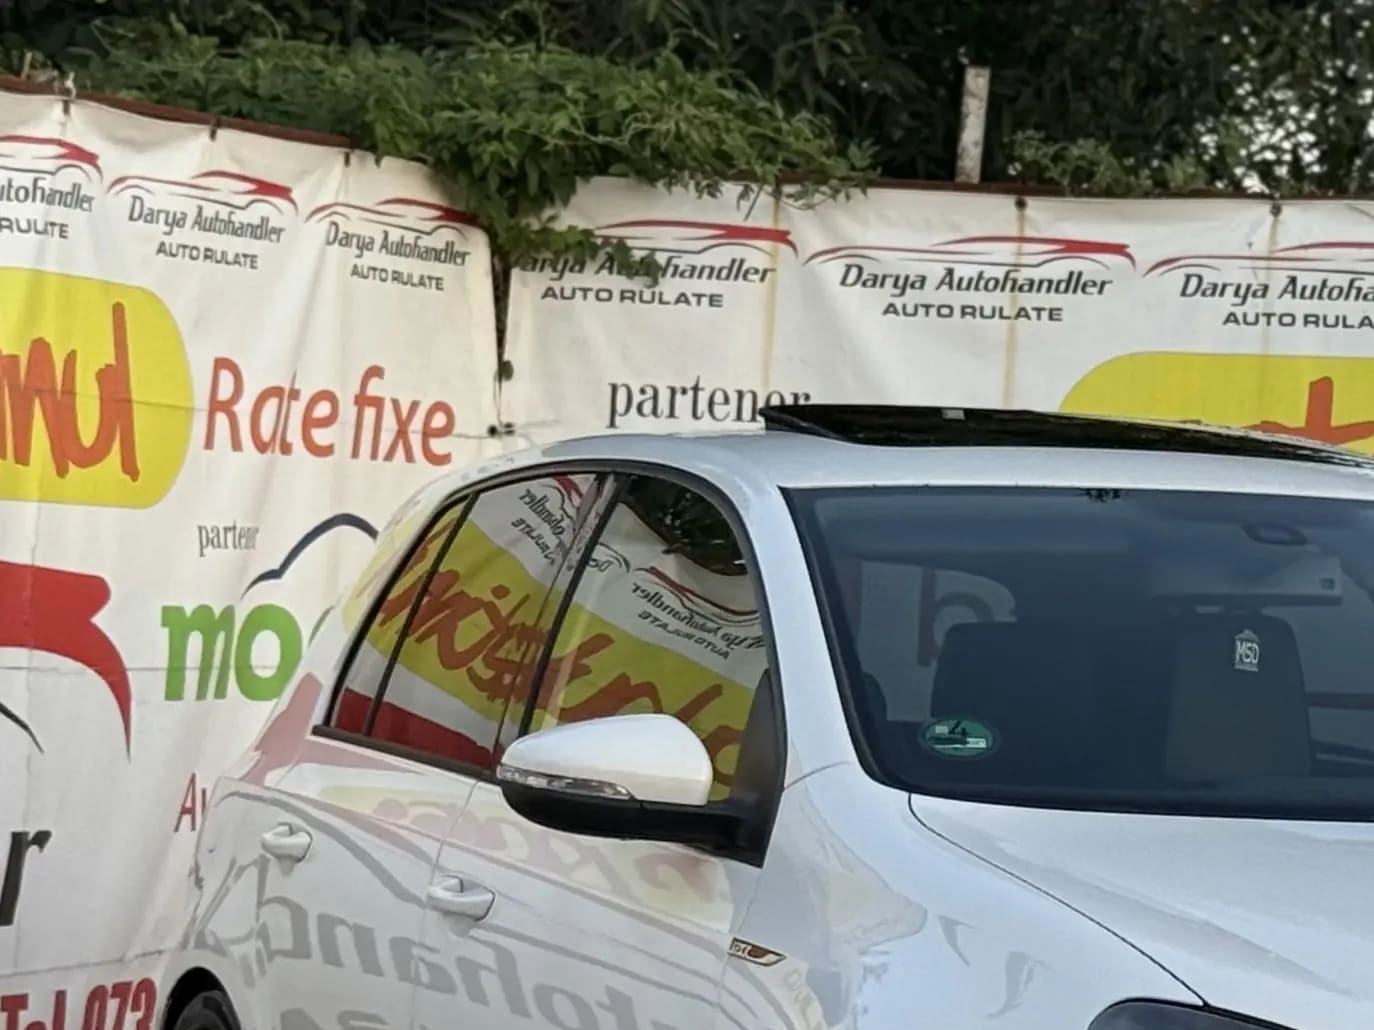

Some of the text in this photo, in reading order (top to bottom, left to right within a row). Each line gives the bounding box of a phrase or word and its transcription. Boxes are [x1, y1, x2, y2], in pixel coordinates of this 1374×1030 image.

[0, 177, 95, 212] tohandler
[128, 195, 285, 243] Darya Autohandler
[156, 241, 258, 269] AUTO RULATE
[325, 221, 470, 266] Darya Autohandler
[351, 264, 444, 291] AUTO RULATE
[512, 250, 776, 284] arya Ahandler
[840, 263, 1113, 297] Darya Autohandler
[541, 286, 724, 308] AUTO RULATE
[1179, 274, 1269, 306] Darya
[882, 302, 1063, 322] AUTO RULATE
[1222, 311, 1296, 327] AUTO
[203, 357, 455, 467] Rate fixe
